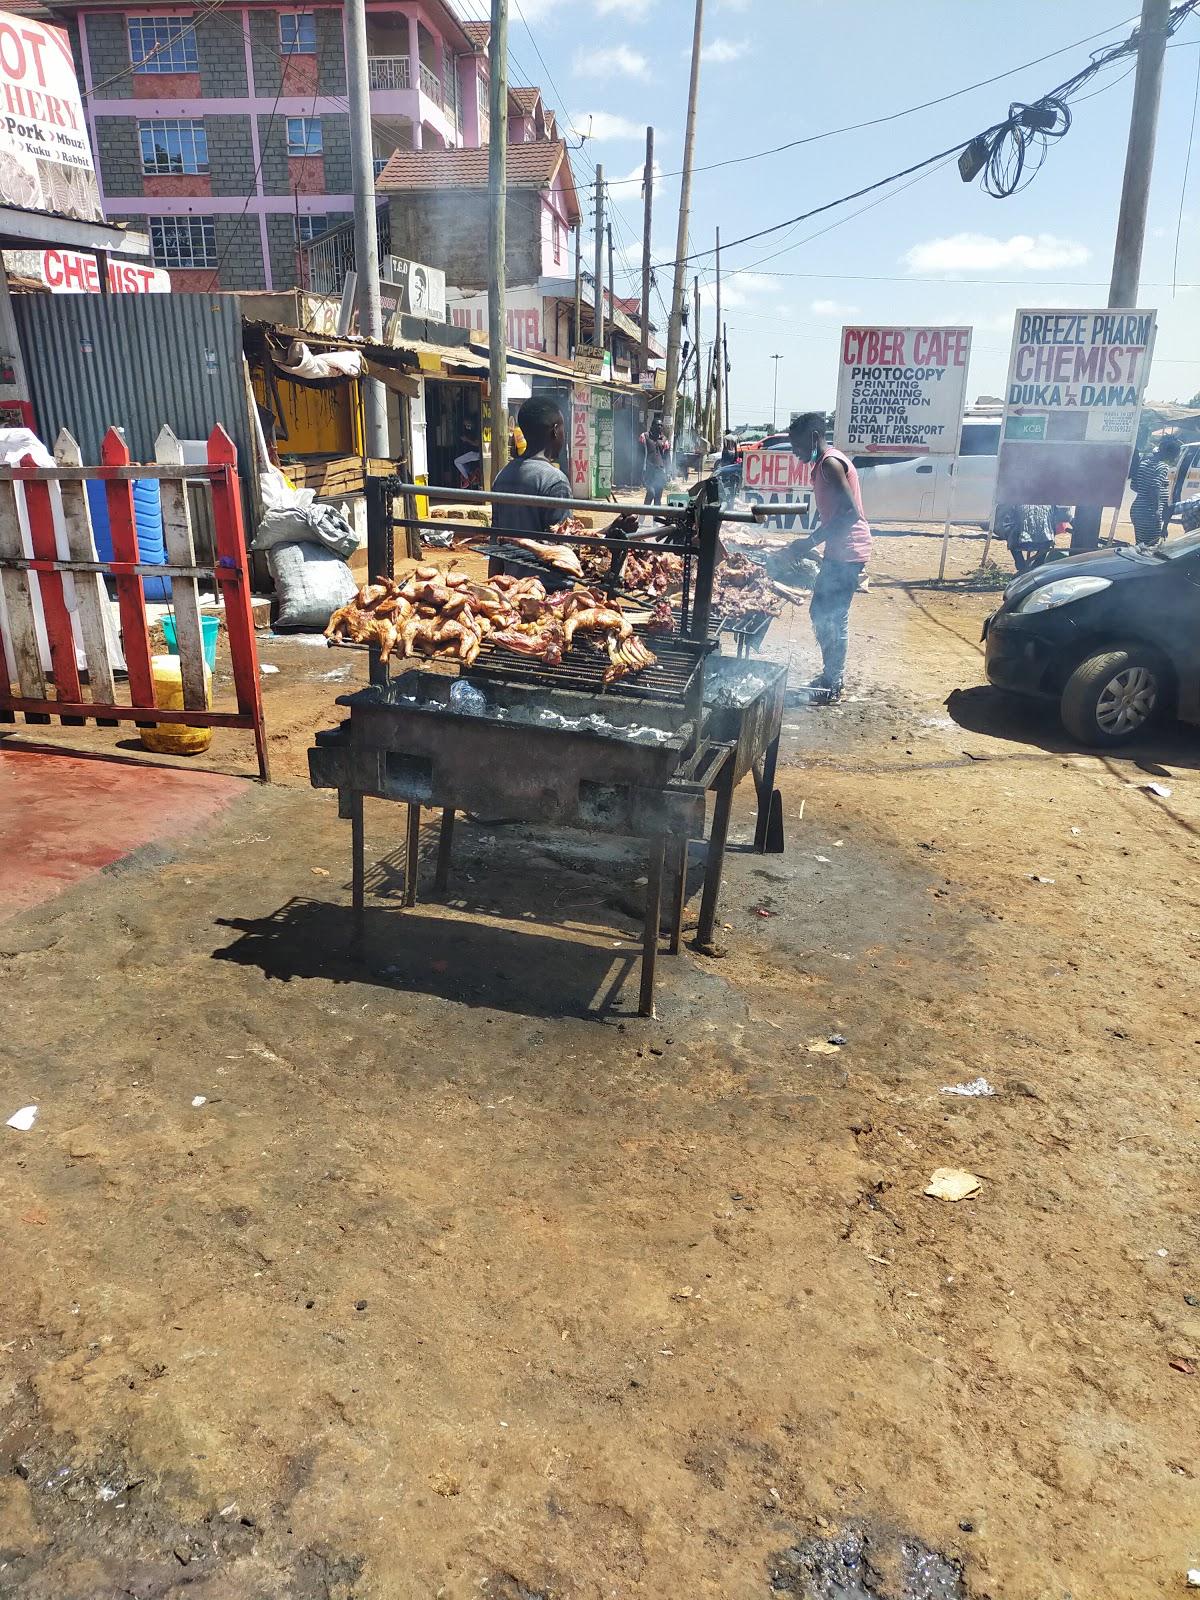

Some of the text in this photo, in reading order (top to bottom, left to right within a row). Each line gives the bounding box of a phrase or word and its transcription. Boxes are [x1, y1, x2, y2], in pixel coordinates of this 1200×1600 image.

[0, 83, 79, 131] HERY
[5, 116, 45, 141] Pork
[56, 132, 86, 150] Mbuzi
[26, 143, 90, 167] Kuku Rabbit
[1019, 315, 1150, 345] BREEZE PHARM
[843, 330, 969, 367] CYBER CAFE
[851, 367, 946, 381] PHOTOCOPY
[1015, 346, 1145, 384] CHEMIST
[852, 389, 923, 397] SCANNING
[854, 381, 920, 389] PRINTING
[851, 397, 931, 406] LAMINATION
[1008, 384, 1061, 406] DUKA
[1080, 385, 1138, 406] DAWA
[850, 406, 906, 415] BINDING
[850, 415, 908, 425] KRA PIN
[1022, 424, 1041, 433] KCB
[848, 425, 945, 435] INSTANT PASSPORT
[574, 412, 588, 483] MAZIWA
[848, 435, 927, 444] DL RENEWAL
[746, 454, 815, 486] CHEMI
